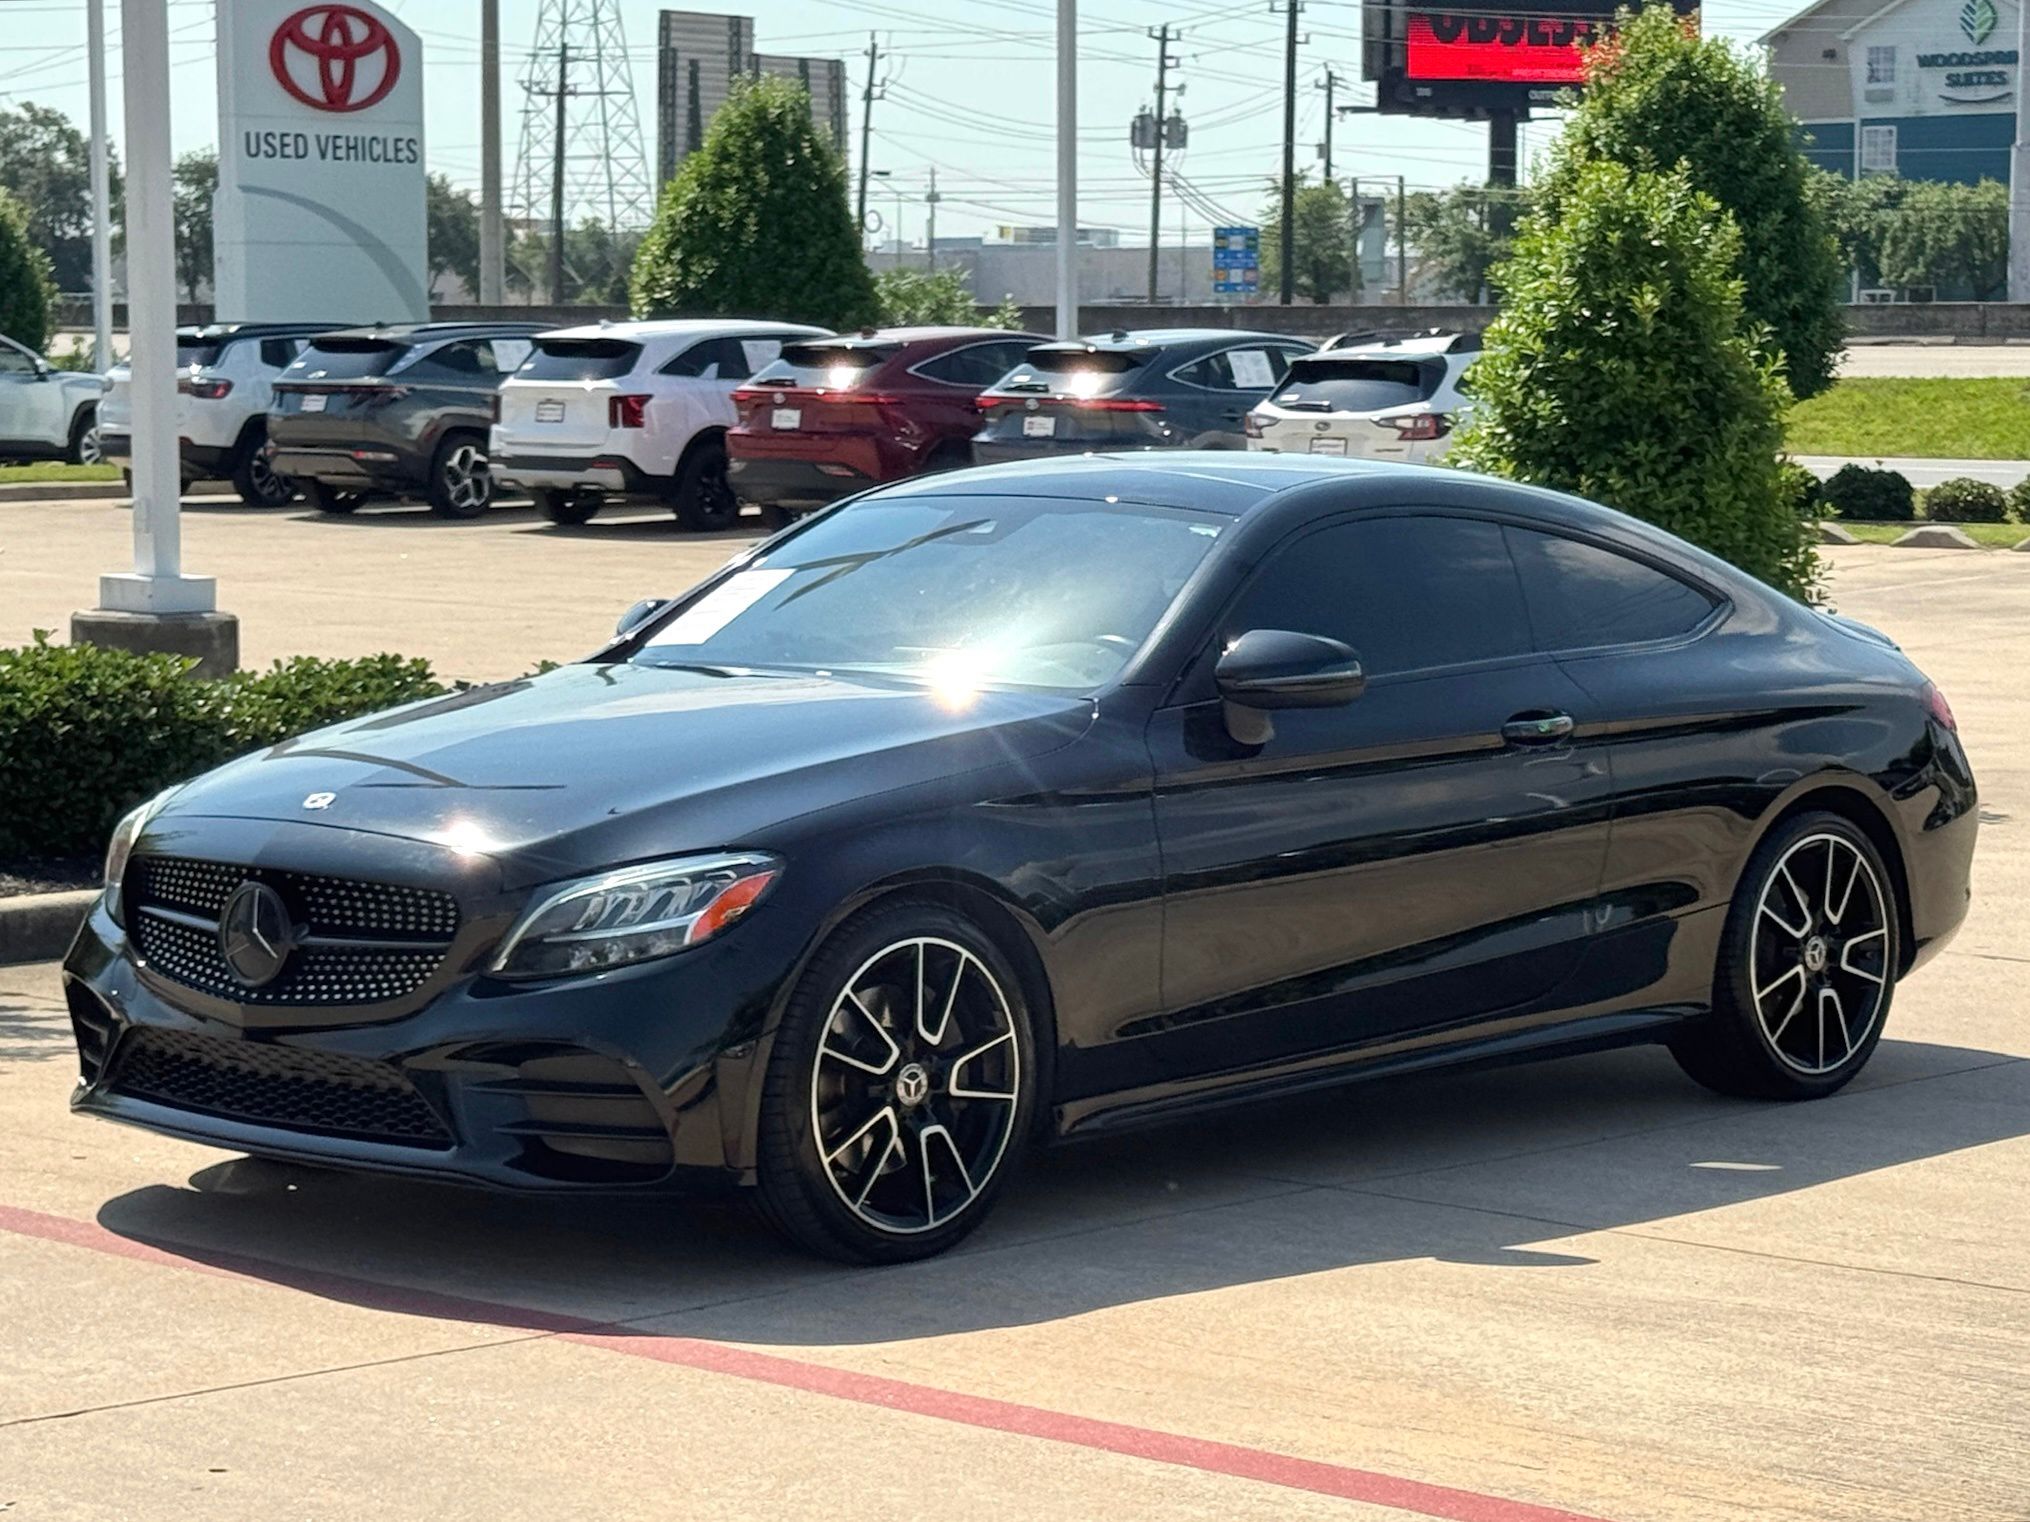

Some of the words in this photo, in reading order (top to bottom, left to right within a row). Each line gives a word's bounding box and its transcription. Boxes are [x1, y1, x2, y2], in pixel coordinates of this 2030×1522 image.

[1944, 70, 2010, 88] SUITES
[244, 131, 309, 159] USED
[314, 134, 419, 164] VEHICLES
